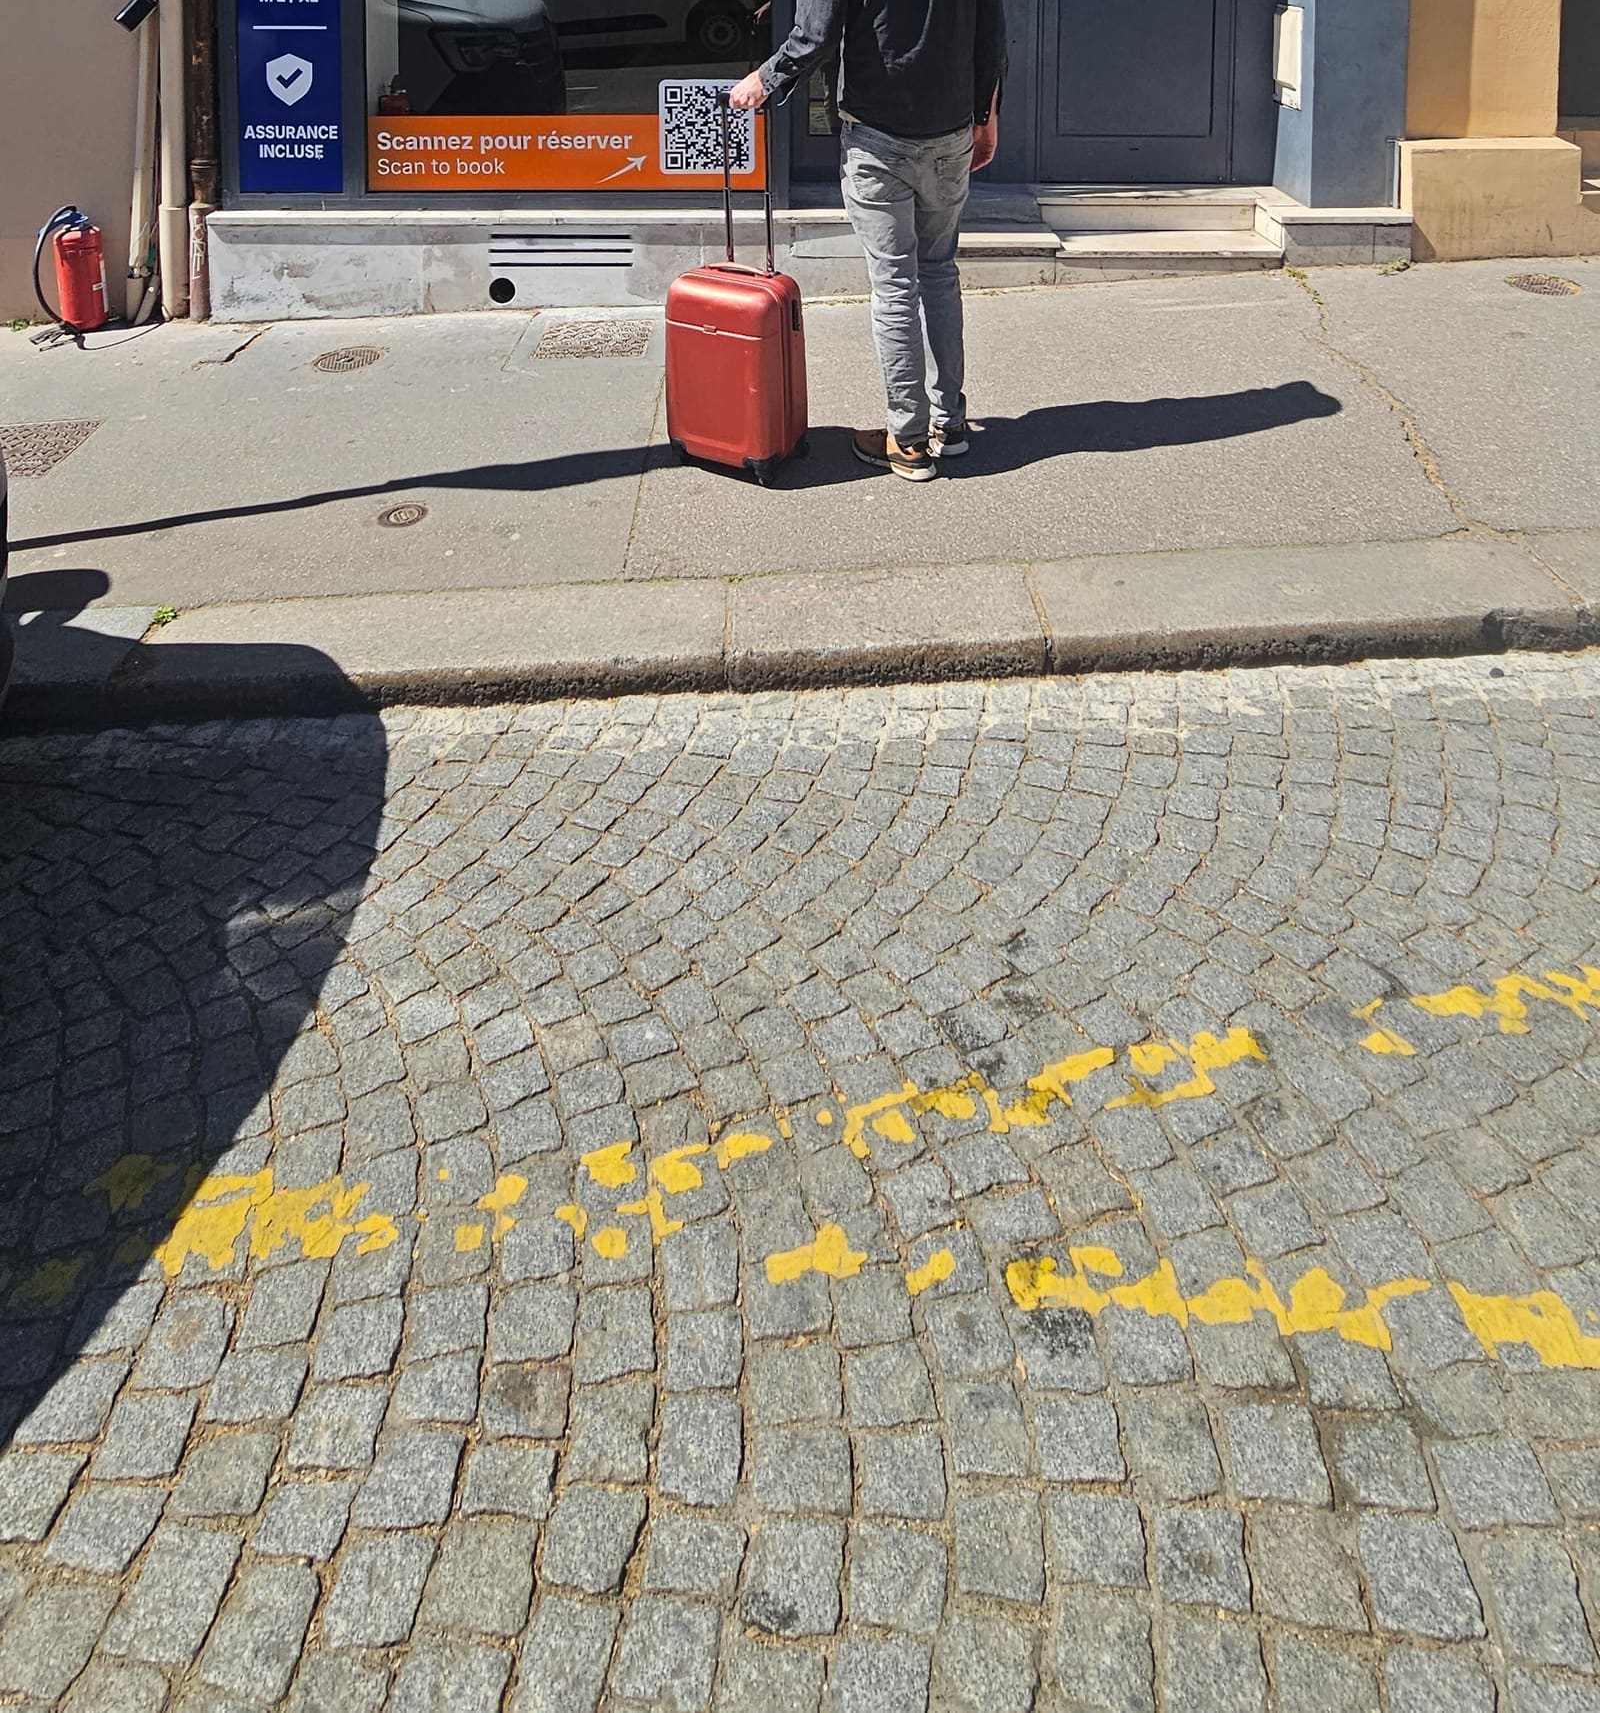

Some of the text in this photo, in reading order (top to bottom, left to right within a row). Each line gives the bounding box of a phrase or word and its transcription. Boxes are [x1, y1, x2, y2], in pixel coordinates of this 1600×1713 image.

[244, 125, 339, 140] ASSURANCE
[377, 130, 633, 155] Scannez pour réserver
[259, 143, 324, 160] INCLUSE
[377, 157, 505, 175] Scan to book
